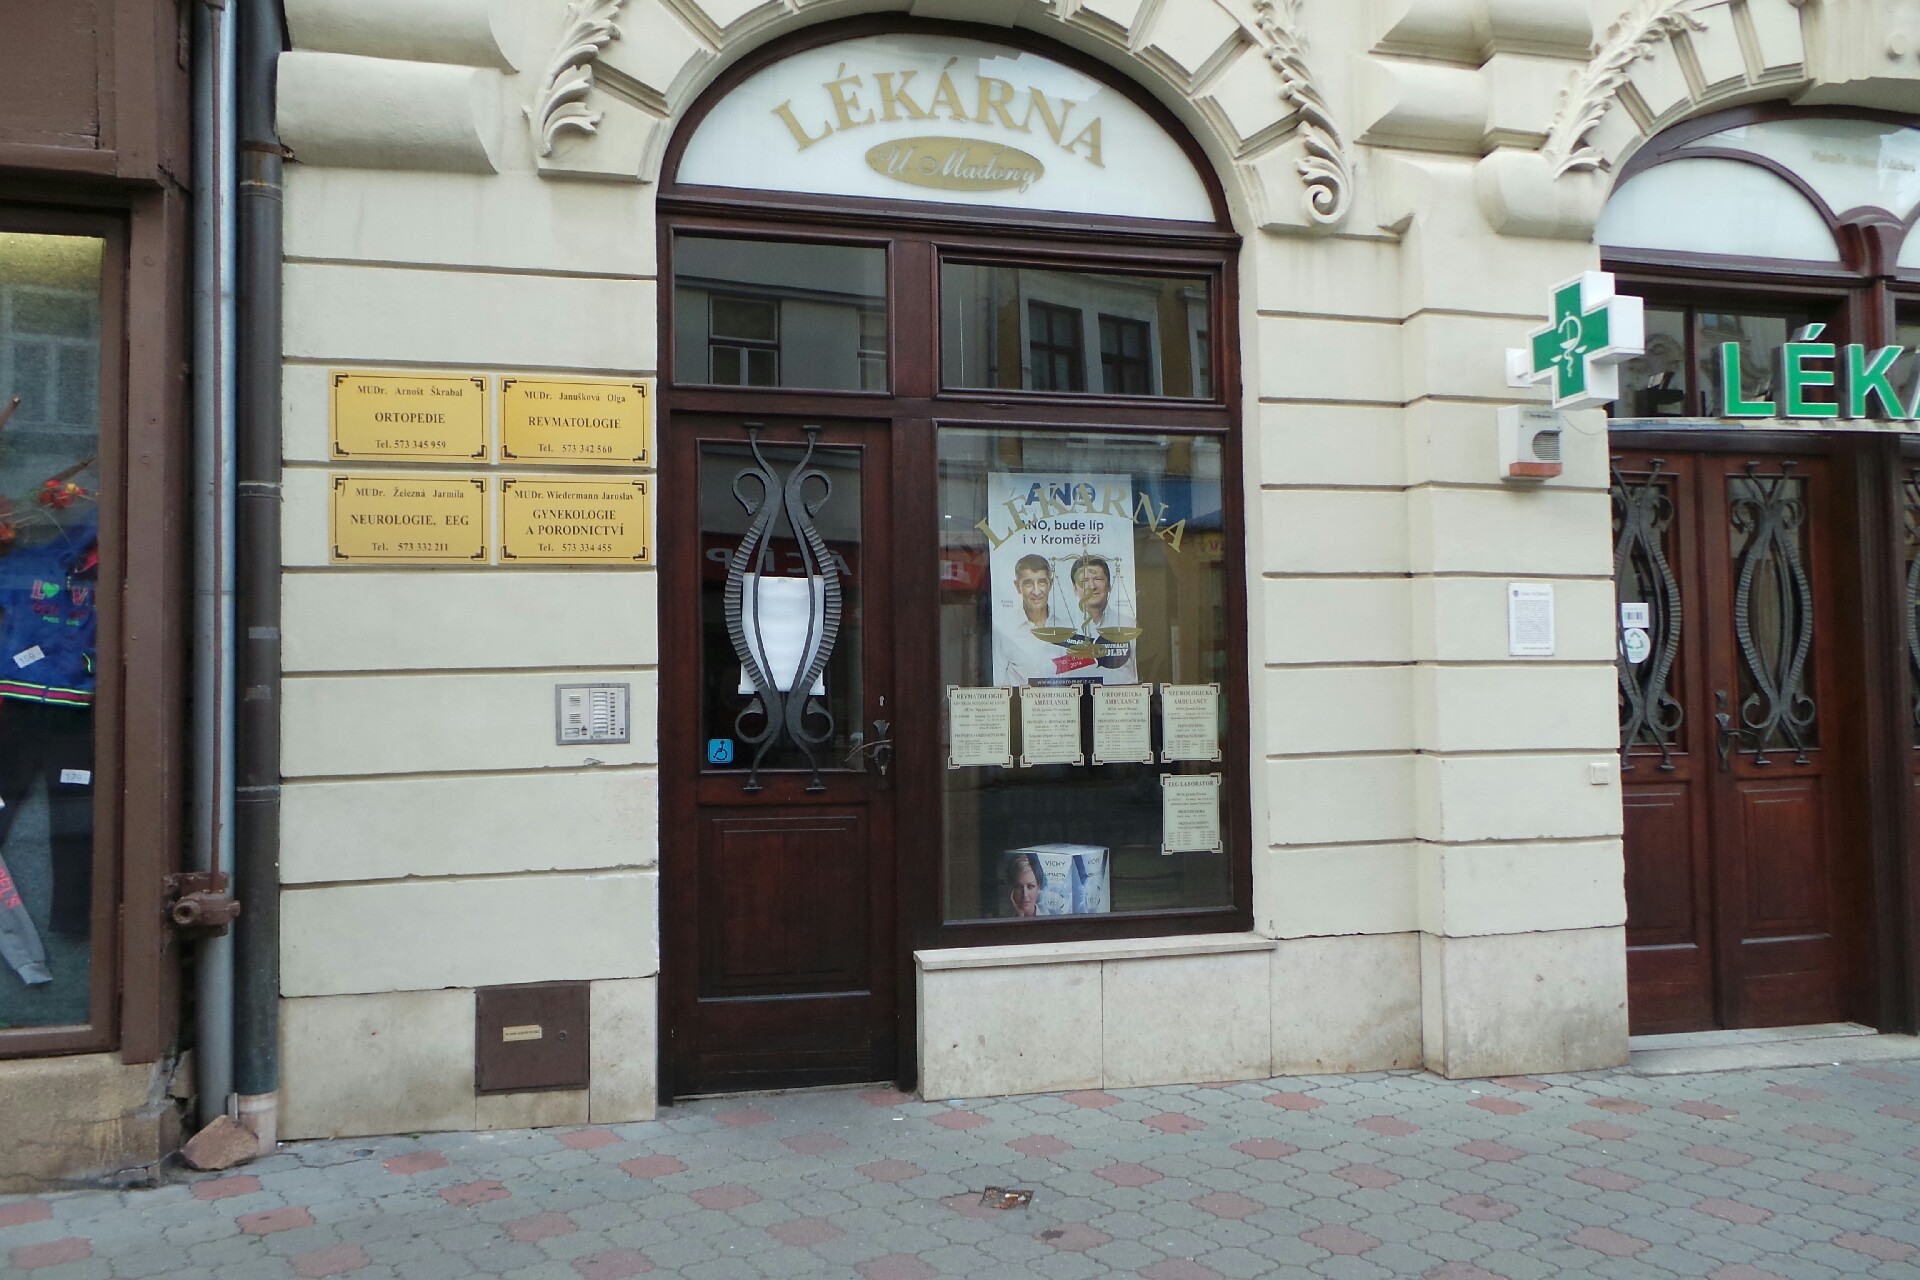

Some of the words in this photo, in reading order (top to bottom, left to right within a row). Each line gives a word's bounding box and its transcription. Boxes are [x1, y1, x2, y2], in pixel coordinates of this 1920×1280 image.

[770, 57, 1106, 169] LÉKÁRNA
[877, 146, 918, 174] U
[918, 148, 1038, 193] Madony
[1722, 322, 1920, 420] LÉK
[357, 385, 388, 395] MUDr.
[395, 386, 424, 396] Arnošt
[430, 385, 463, 397] Škrabal
[524, 390, 552, 400] MUDr.
[558, 391, 601, 402] Janušková
[607, 393, 626, 404] Olga
[374, 411, 446, 424] ORTOPEDIE
[528, 415, 622, 429] REVMATOLOGIE
[375, 439, 392, 449] Tel.
[394, 439, 410, 449] 573
[413, 439, 429, 449] 345
[431, 440, 446, 450] 959
[538, 443, 554, 453] Tel.
[562, 444, 577, 453] 573
[579, 444, 594, 454] 342
[355, 487, 386, 498] MUDr.
[393, 486, 426, 498] Železná
[432, 488, 464, 499] Jarmila
[514, 490, 544, 500] MUDr.
[546, 490, 599, 500] Wiedermann
[601, 491, 635, 501] Jaroslav
[445, 514, 469, 526] EEG
[532, 509, 616, 520] GYNEKOLOGIE
[974, 474, 1186, 553] LÉKÁRNA
[525, 525, 534, 535] A
[538, 523, 624, 536] PORODNICTVÍ
[1054, 519, 1086, 531] bude
[1089, 519, 1104, 532] líp
[1030, 536, 1038, 545] v
[1041, 533, 1101, 545] Kroměříži
[371, 542, 388, 551] Tel.
[398, 542, 414, 551] 573
[416, 542, 432, 551] 332
[434, 543, 449, 551] 211
[538, 543, 554, 552] Tel.
[562, 543, 577, 552] 573
[579, 543, 595, 552] 334
[597, 543, 613, 552] 455
